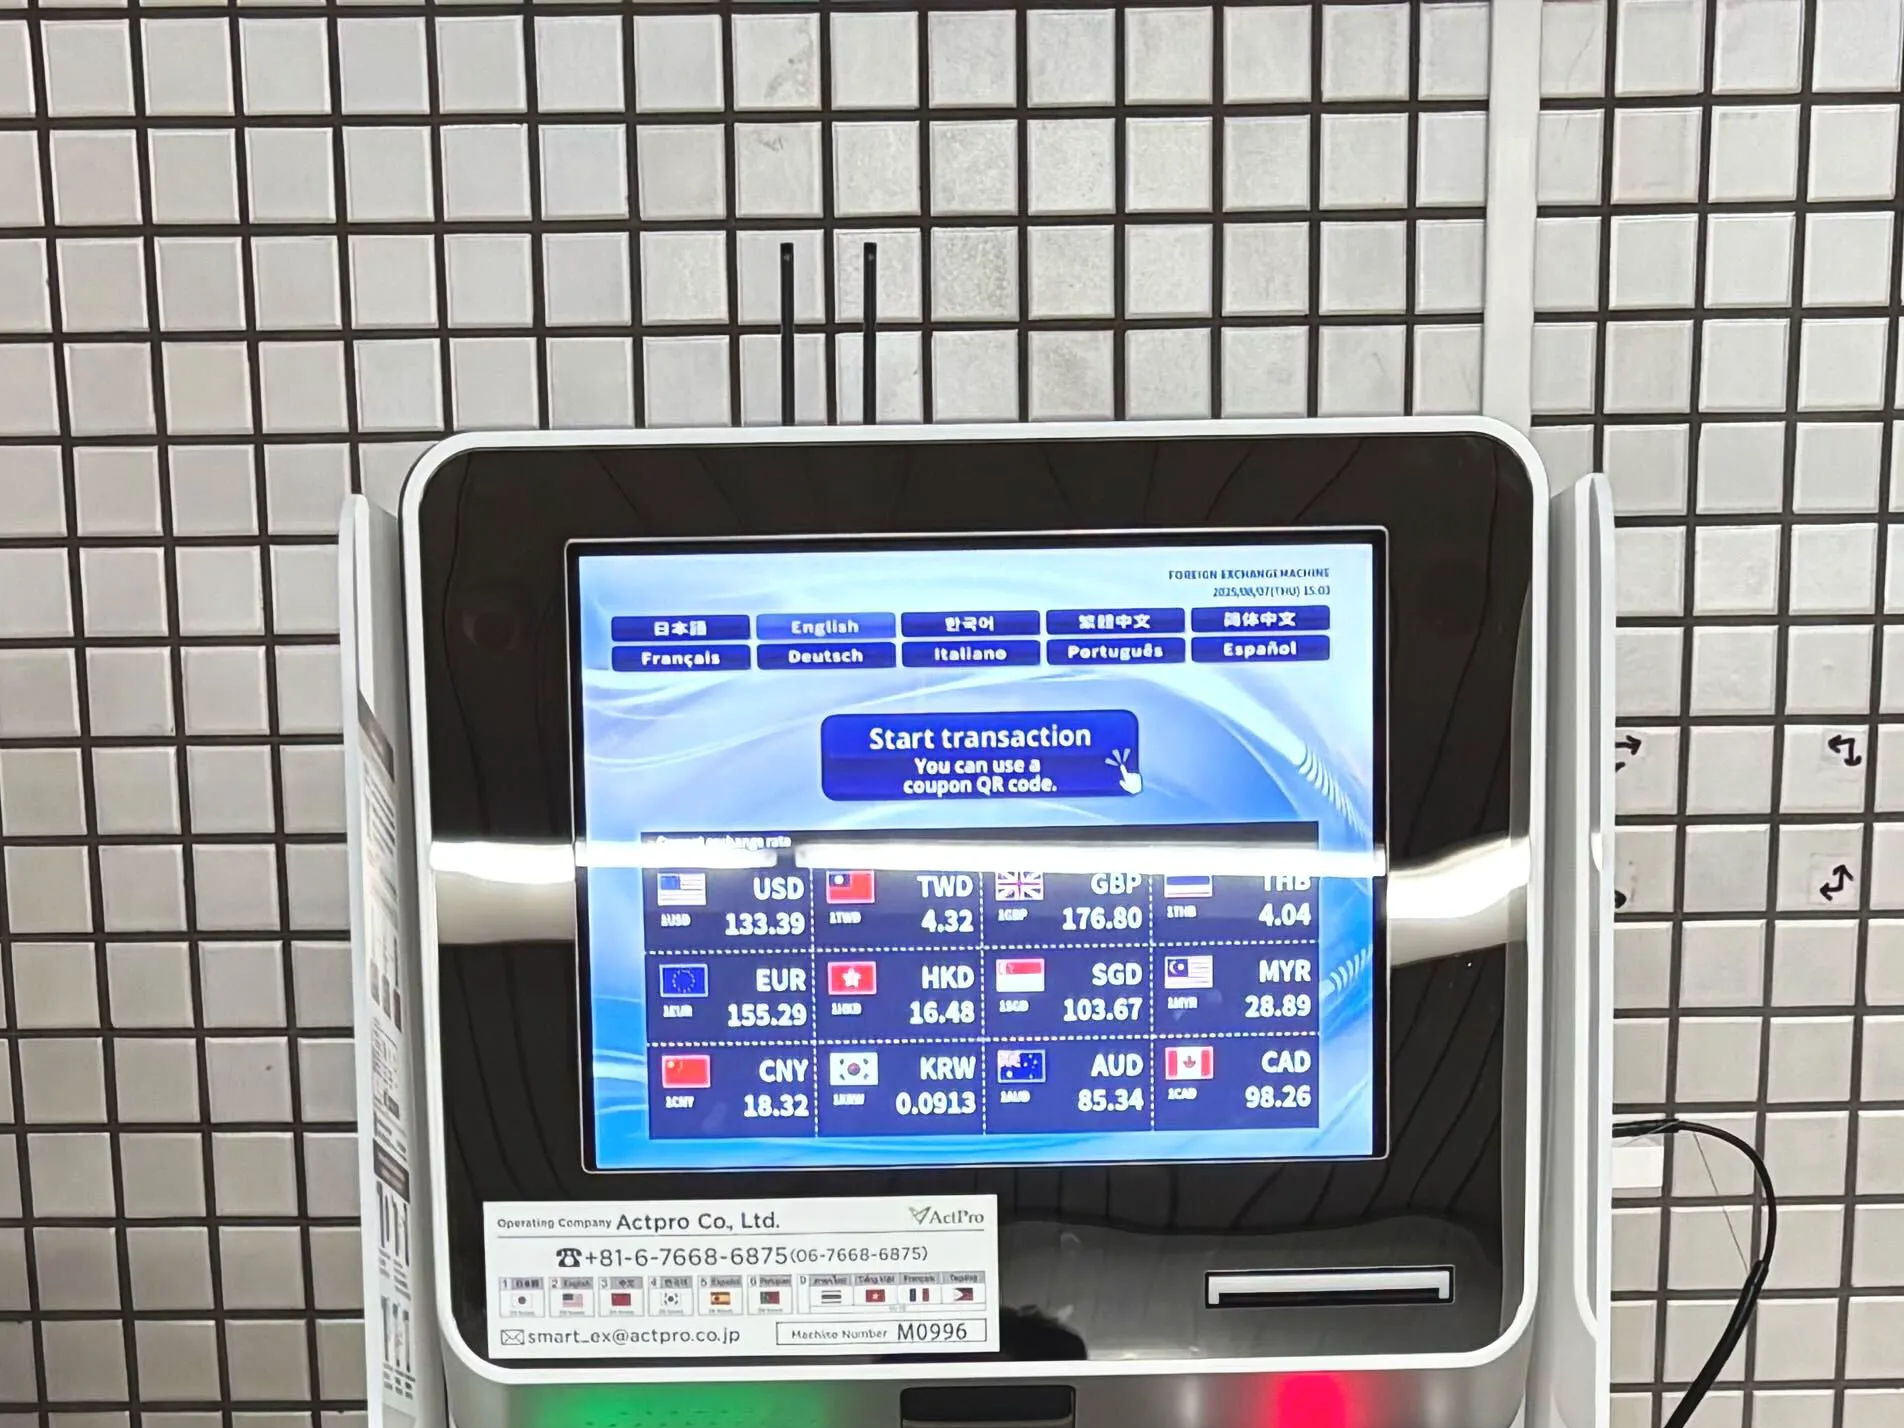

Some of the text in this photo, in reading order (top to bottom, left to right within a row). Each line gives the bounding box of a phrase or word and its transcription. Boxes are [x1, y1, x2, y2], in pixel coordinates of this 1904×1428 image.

[653, 620, 707, 636] 日本語
[790, 619, 860, 638] English
[945, 617, 994, 633] 한국어
[641, 650, 721, 668] Français
[788, 648, 864, 665] Deutsch
[934, 647, 1007, 662] Italiano
[1067, 643, 1163, 661] Português
[1224, 641, 1297, 659] Español
[869, 724, 1091, 750] Start transaction
[914, 758, 1041, 775] You can use a
[903, 774, 1058, 798] coupon QR code.
[753, 877, 805, 901] USD
[916, 875, 973, 898] TWD
[1090, 873, 1143, 895] GBP
[725, 912, 806, 936] 133.39
[920, 908, 974, 933] 4.32
[1062, 907, 1143, 931] 176.80
[1258, 903, 1312, 928] 4.04
[755, 968, 807, 992] EUR
[921, 965, 975, 989] HKD
[1092, 962, 1143, 986] SGD
[1258, 959, 1312, 984] MYR
[727, 1003, 807, 1028] 155.29
[909, 1000, 976, 1025] 16.48
[1063, 997, 1143, 1023] 103.67
[1244, 995, 1311, 1018] 28.89
[758, 1059, 809, 1083] CNY
[919, 1056, 977, 1080] KRW
[1090, 1053, 1144, 1078] AUD
[1261, 1050, 1311, 1074] CAD
[744, 1094, 810, 1118] 18.32
[896, 1091, 976, 1115] 0.0913
[1077, 1088, 1144, 1112] 85.34
[1245, 1085, 1312, 1110] 98.26
[497, 1212, 780, 1232] Operating Company Actpro Co., Ltd.
[527, 1326, 741, 1345] smart_ex@actpro.co.jp
[842, 1327, 889, 1342] Number
[896, 1323, 967, 1341] M0996
